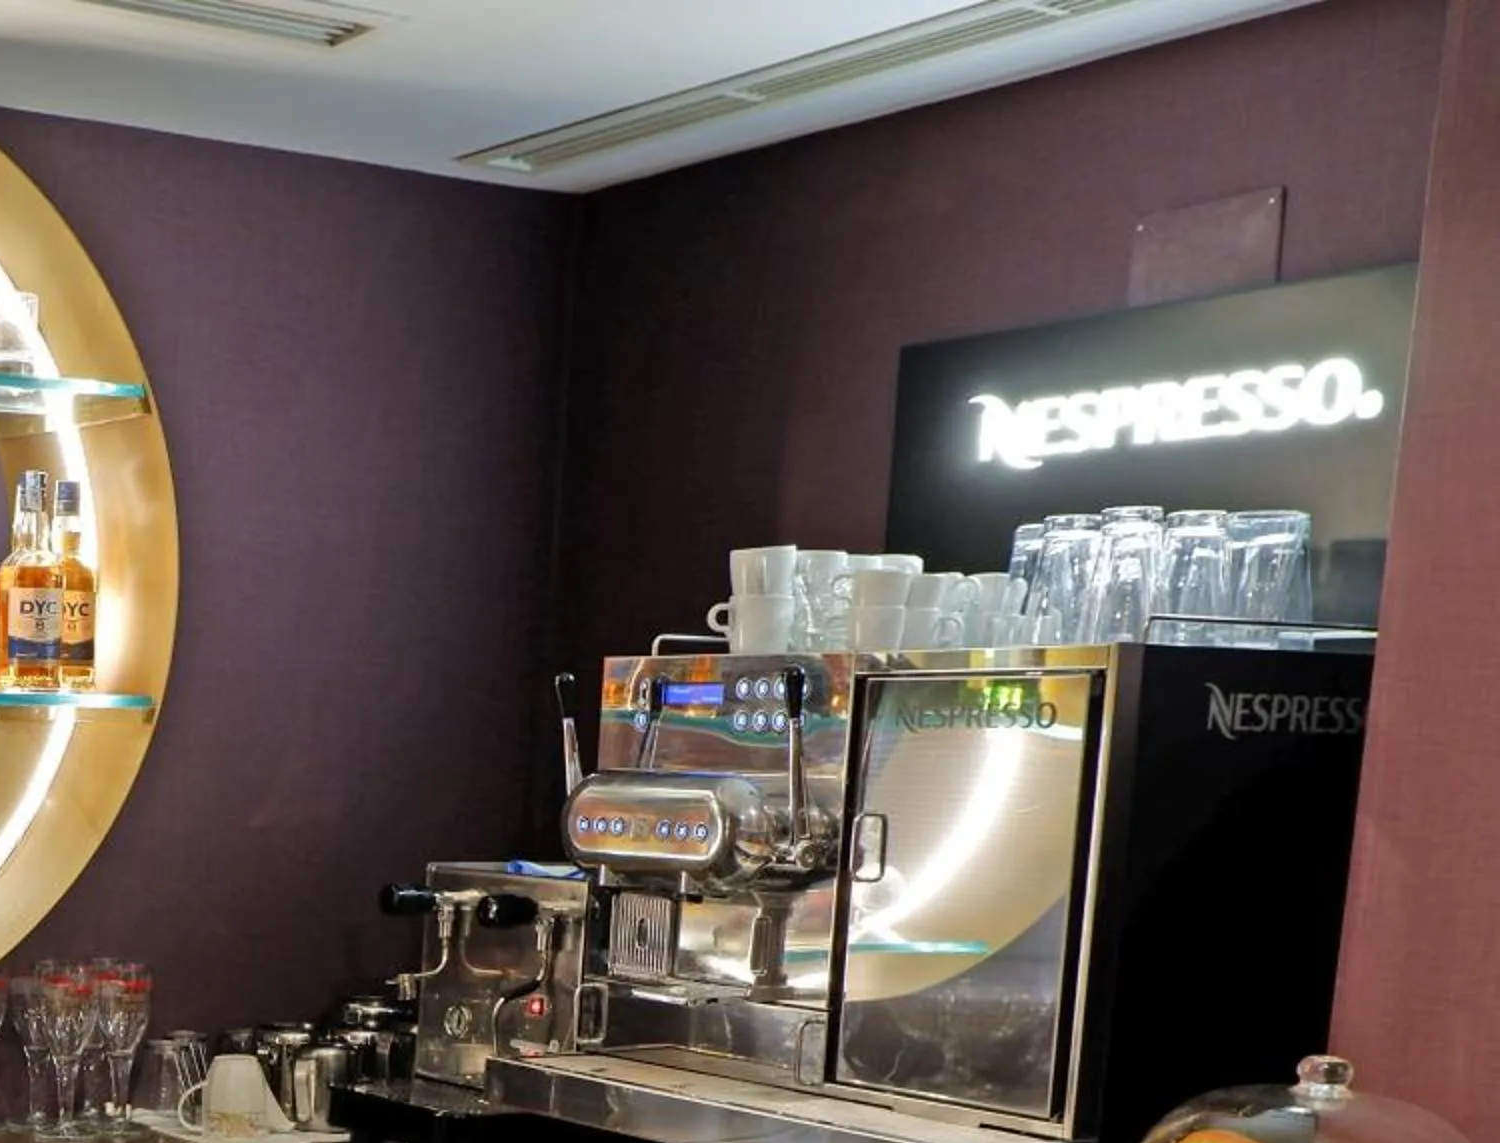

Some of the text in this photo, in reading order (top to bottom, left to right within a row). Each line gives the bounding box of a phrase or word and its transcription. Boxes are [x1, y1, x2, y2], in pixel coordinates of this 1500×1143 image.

[20, 600, 58, 616] DYC
[62, 602, 89, 617] YC
[896, 701, 1058, 734] NESPRESSO
[1204, 682, 1362, 740] NESPRESS
